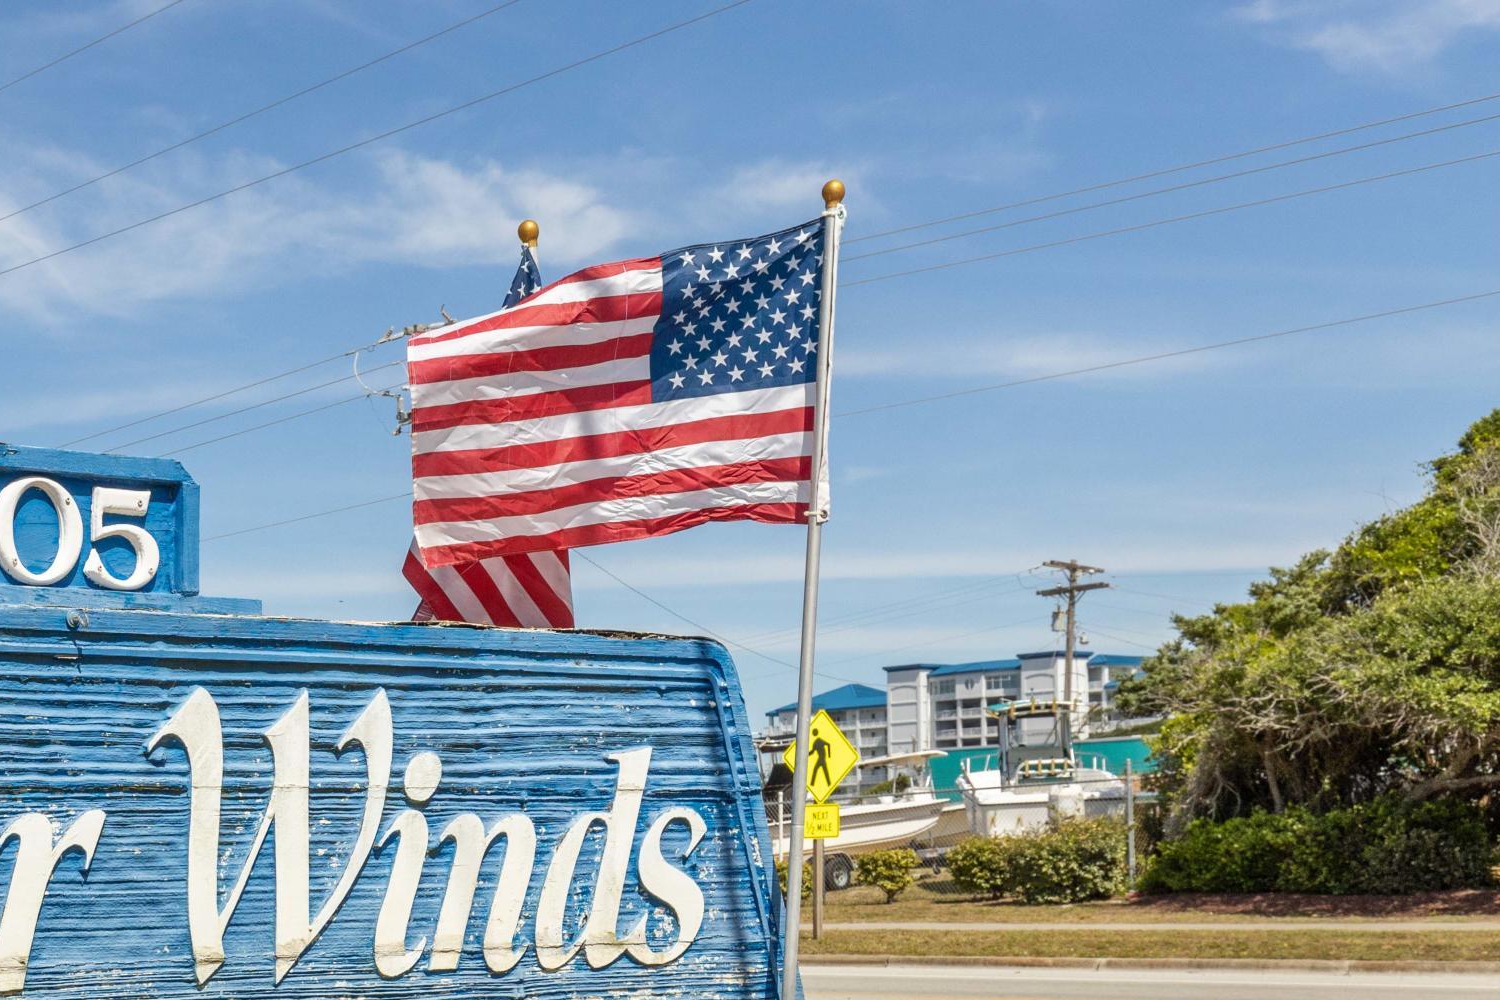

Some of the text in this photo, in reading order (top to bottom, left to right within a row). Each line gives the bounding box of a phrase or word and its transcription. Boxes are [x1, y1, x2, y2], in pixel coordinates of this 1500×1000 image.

[812, 811, 829, 820] NEXT
[817, 823, 832, 832] MILE
[146, 686, 707, 986] Winds
